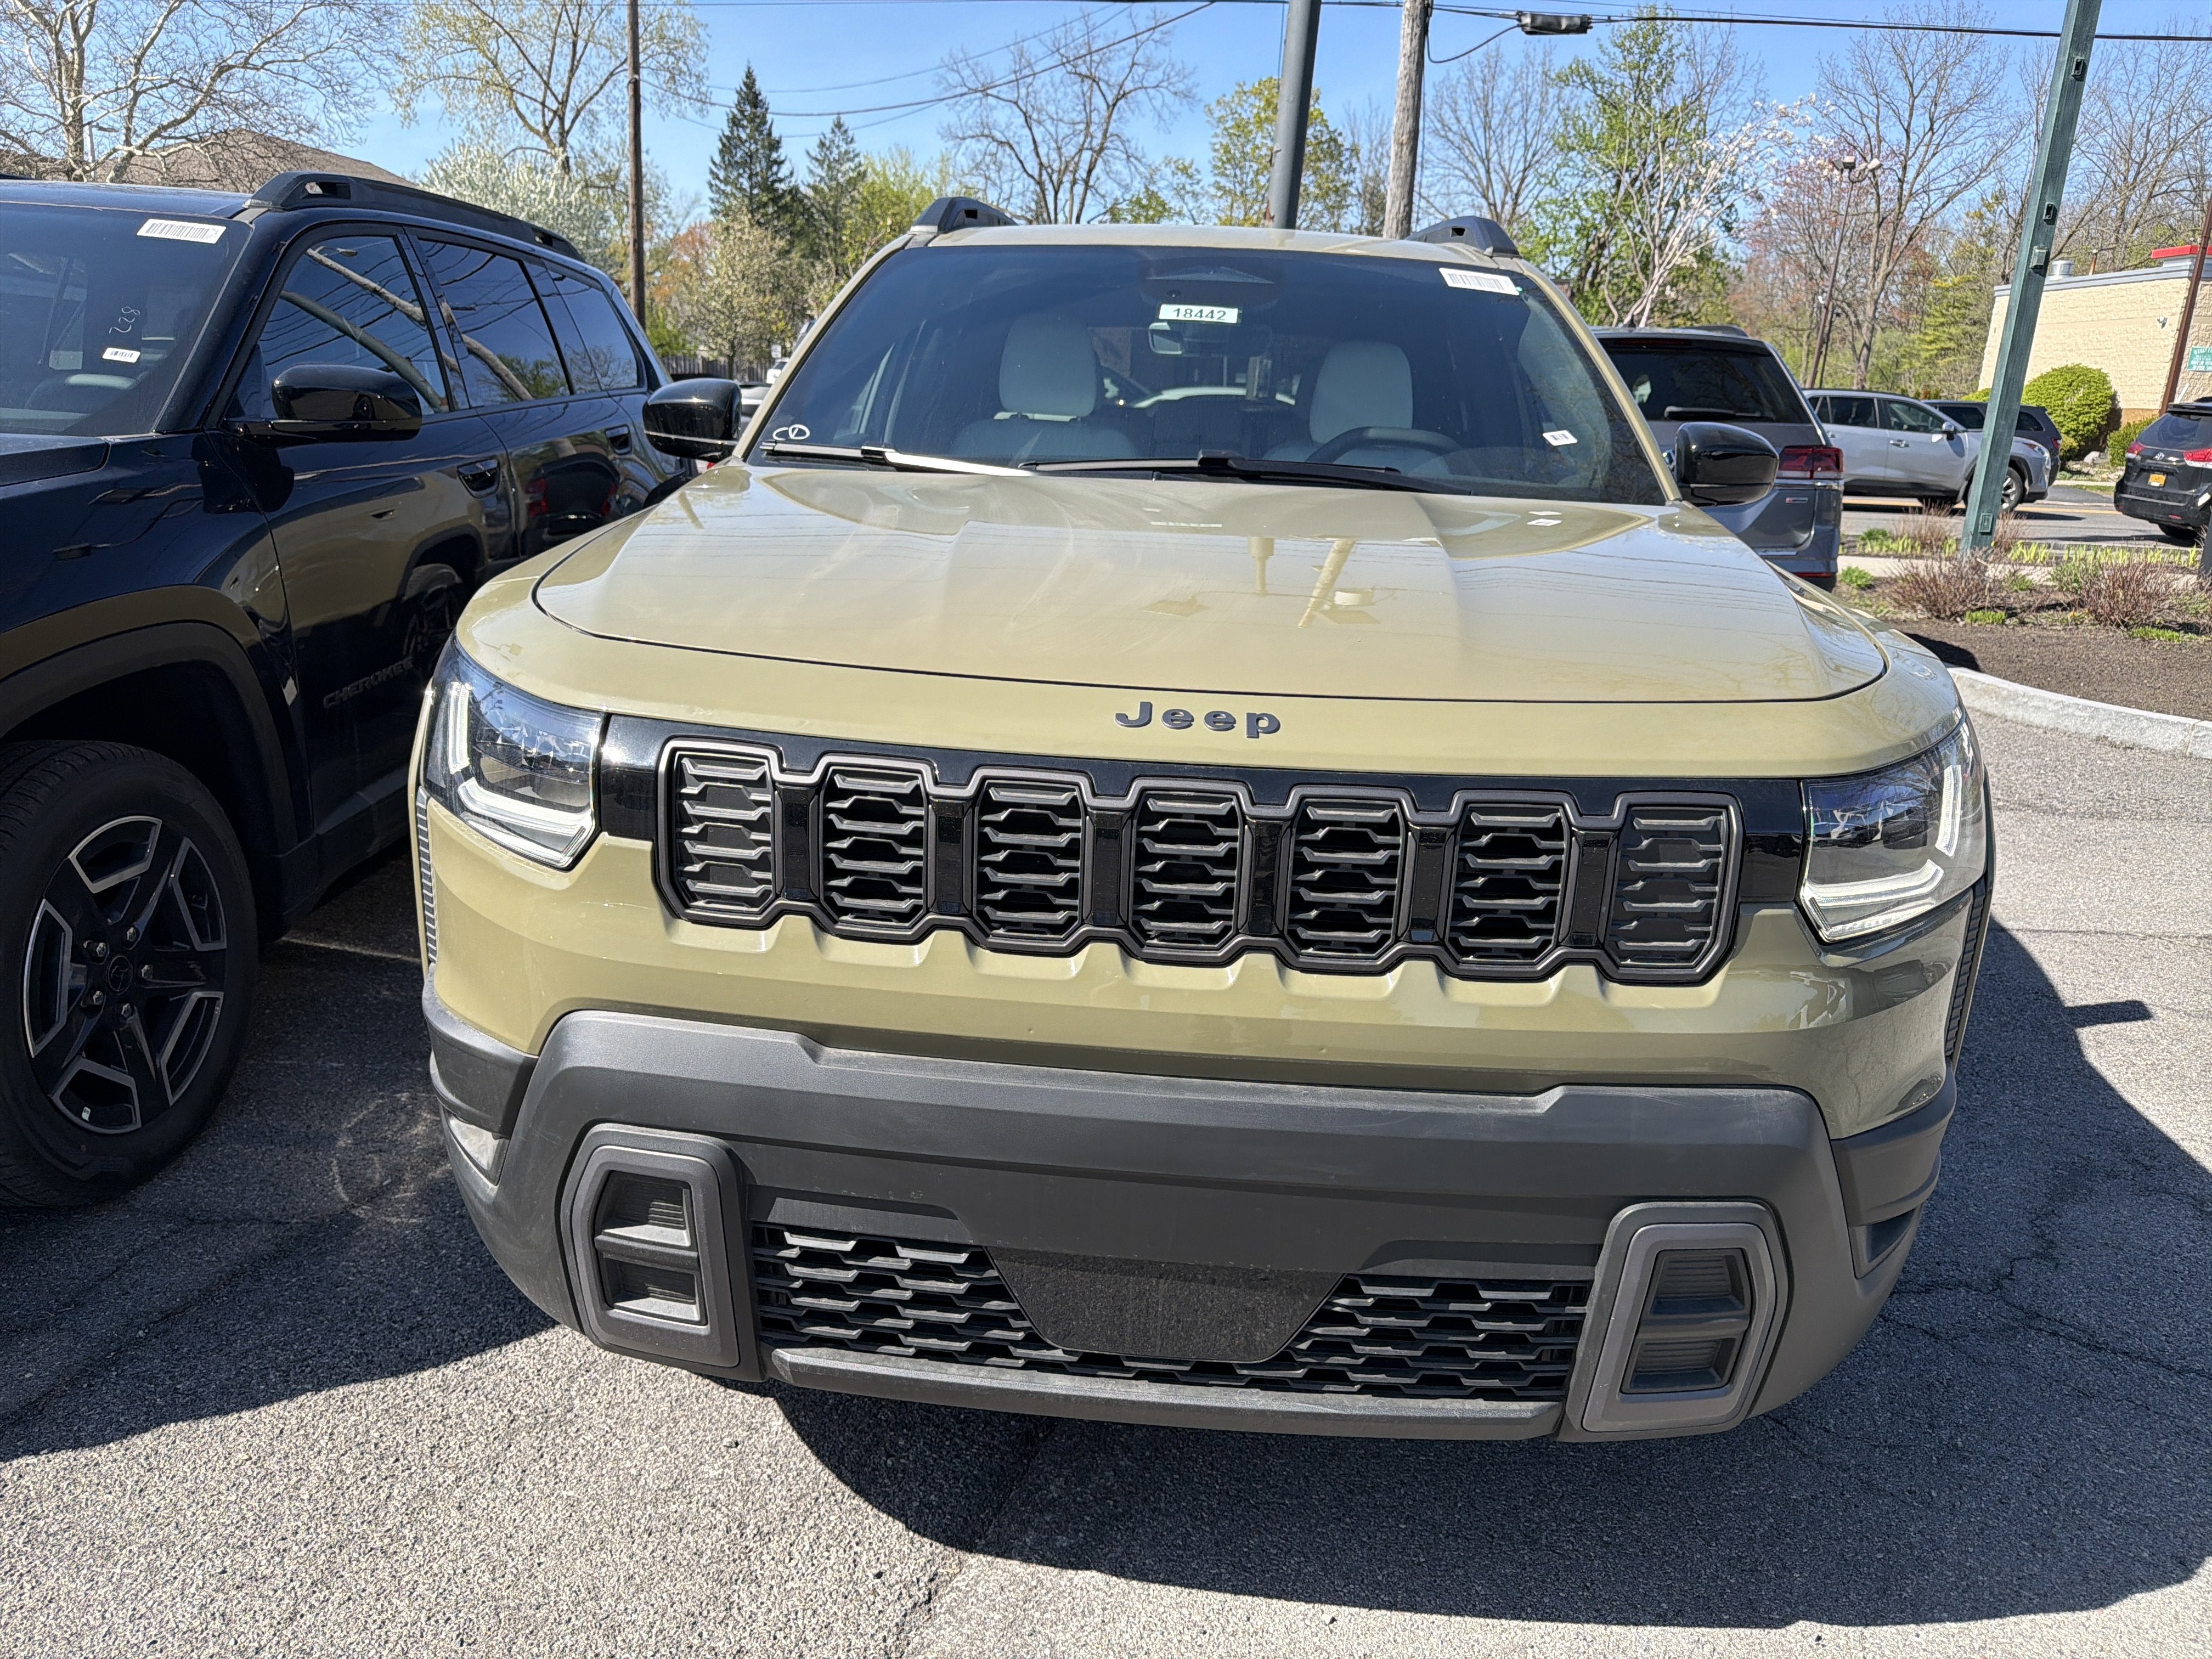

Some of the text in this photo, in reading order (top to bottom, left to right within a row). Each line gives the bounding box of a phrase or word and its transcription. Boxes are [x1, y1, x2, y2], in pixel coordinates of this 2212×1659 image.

[1173, 308, 1227, 321] 18442
[323, 656, 414, 709] CHEROKEE
[1115, 701, 1281, 739] Jeep
